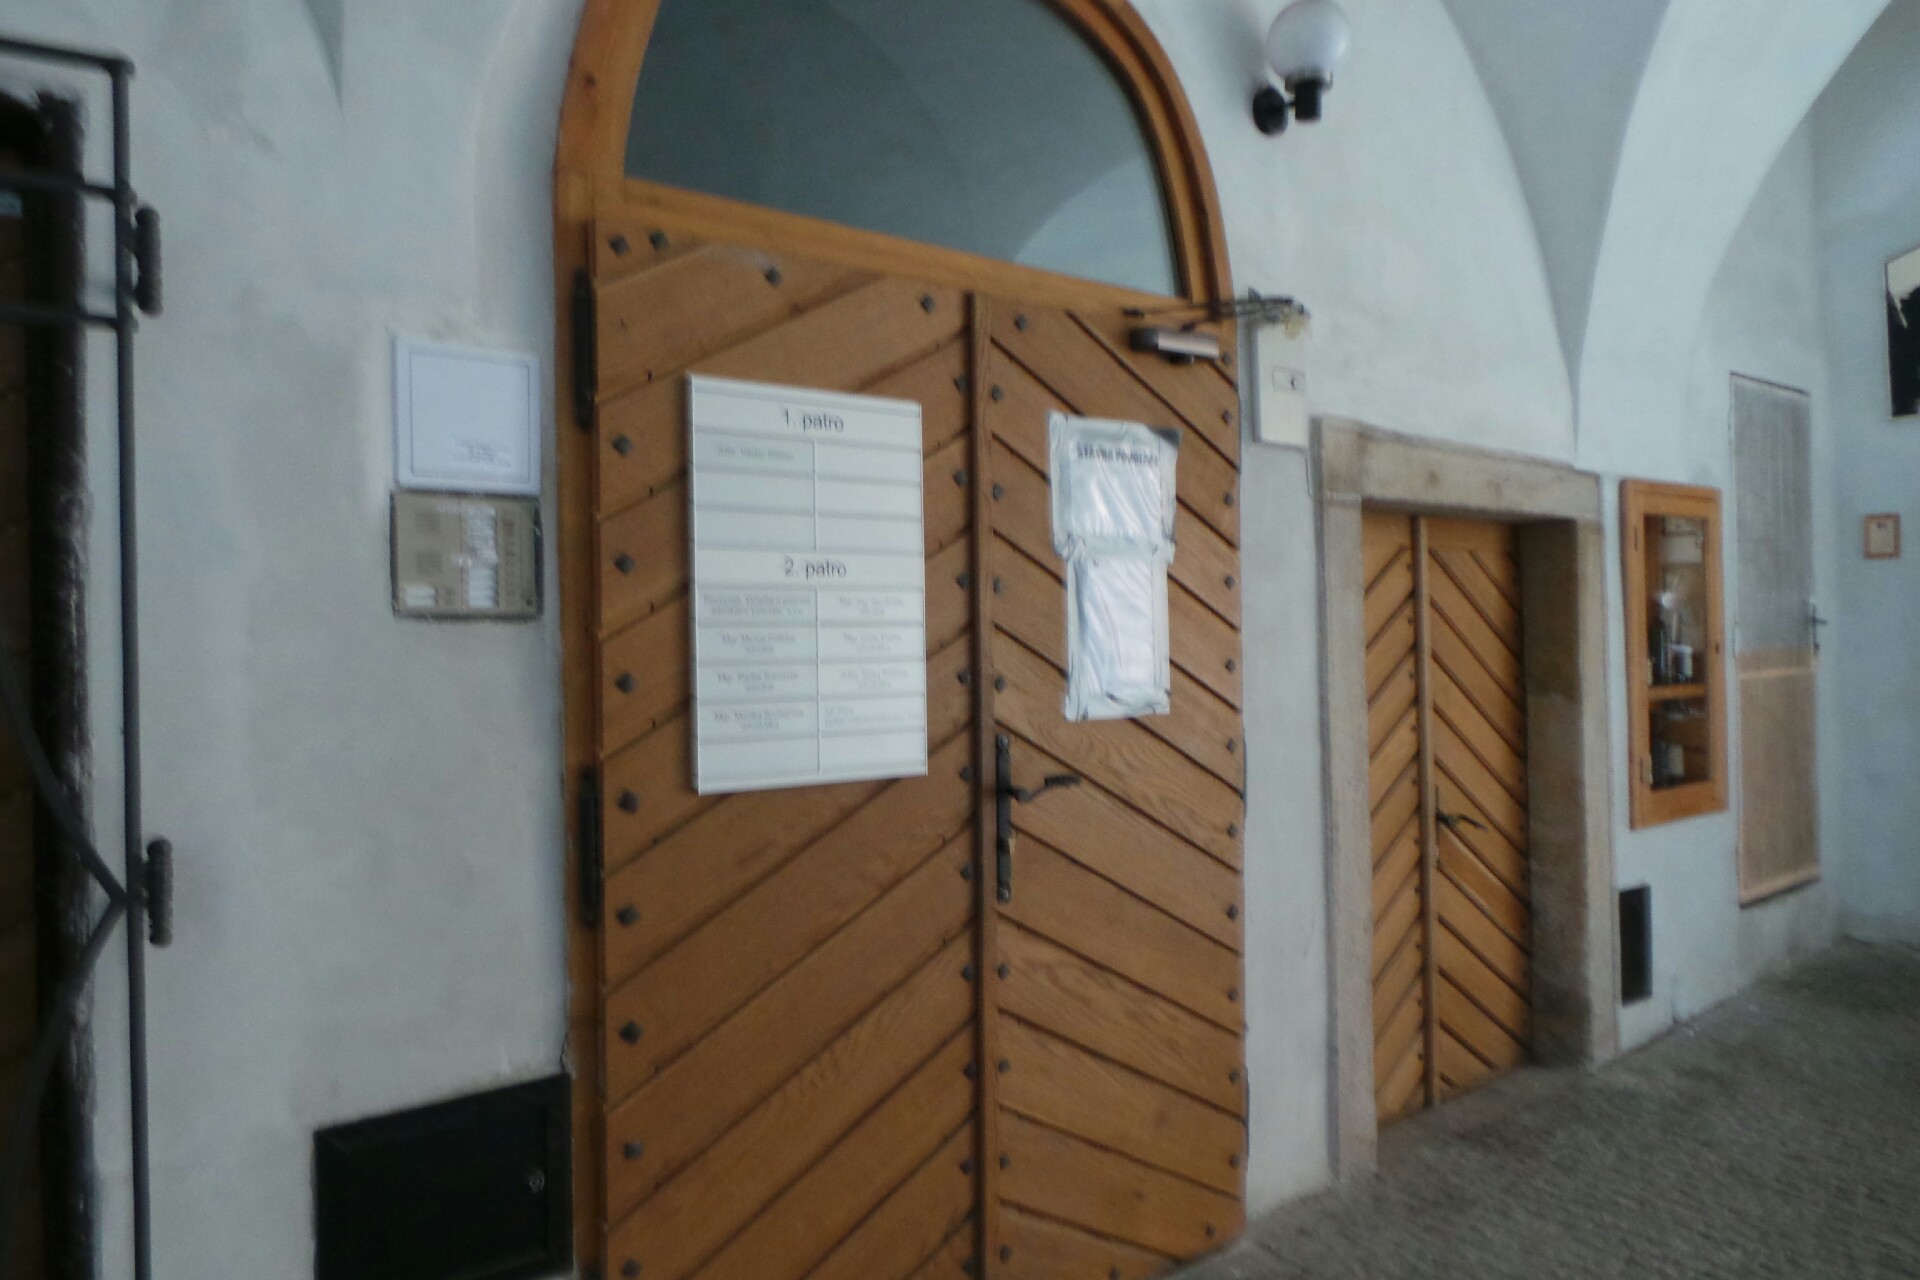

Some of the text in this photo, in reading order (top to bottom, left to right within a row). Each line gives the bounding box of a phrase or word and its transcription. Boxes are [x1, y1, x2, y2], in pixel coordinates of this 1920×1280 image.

[783, 408, 845, 433] 1. patro
[784, 553, 847, 581] 2. patro
